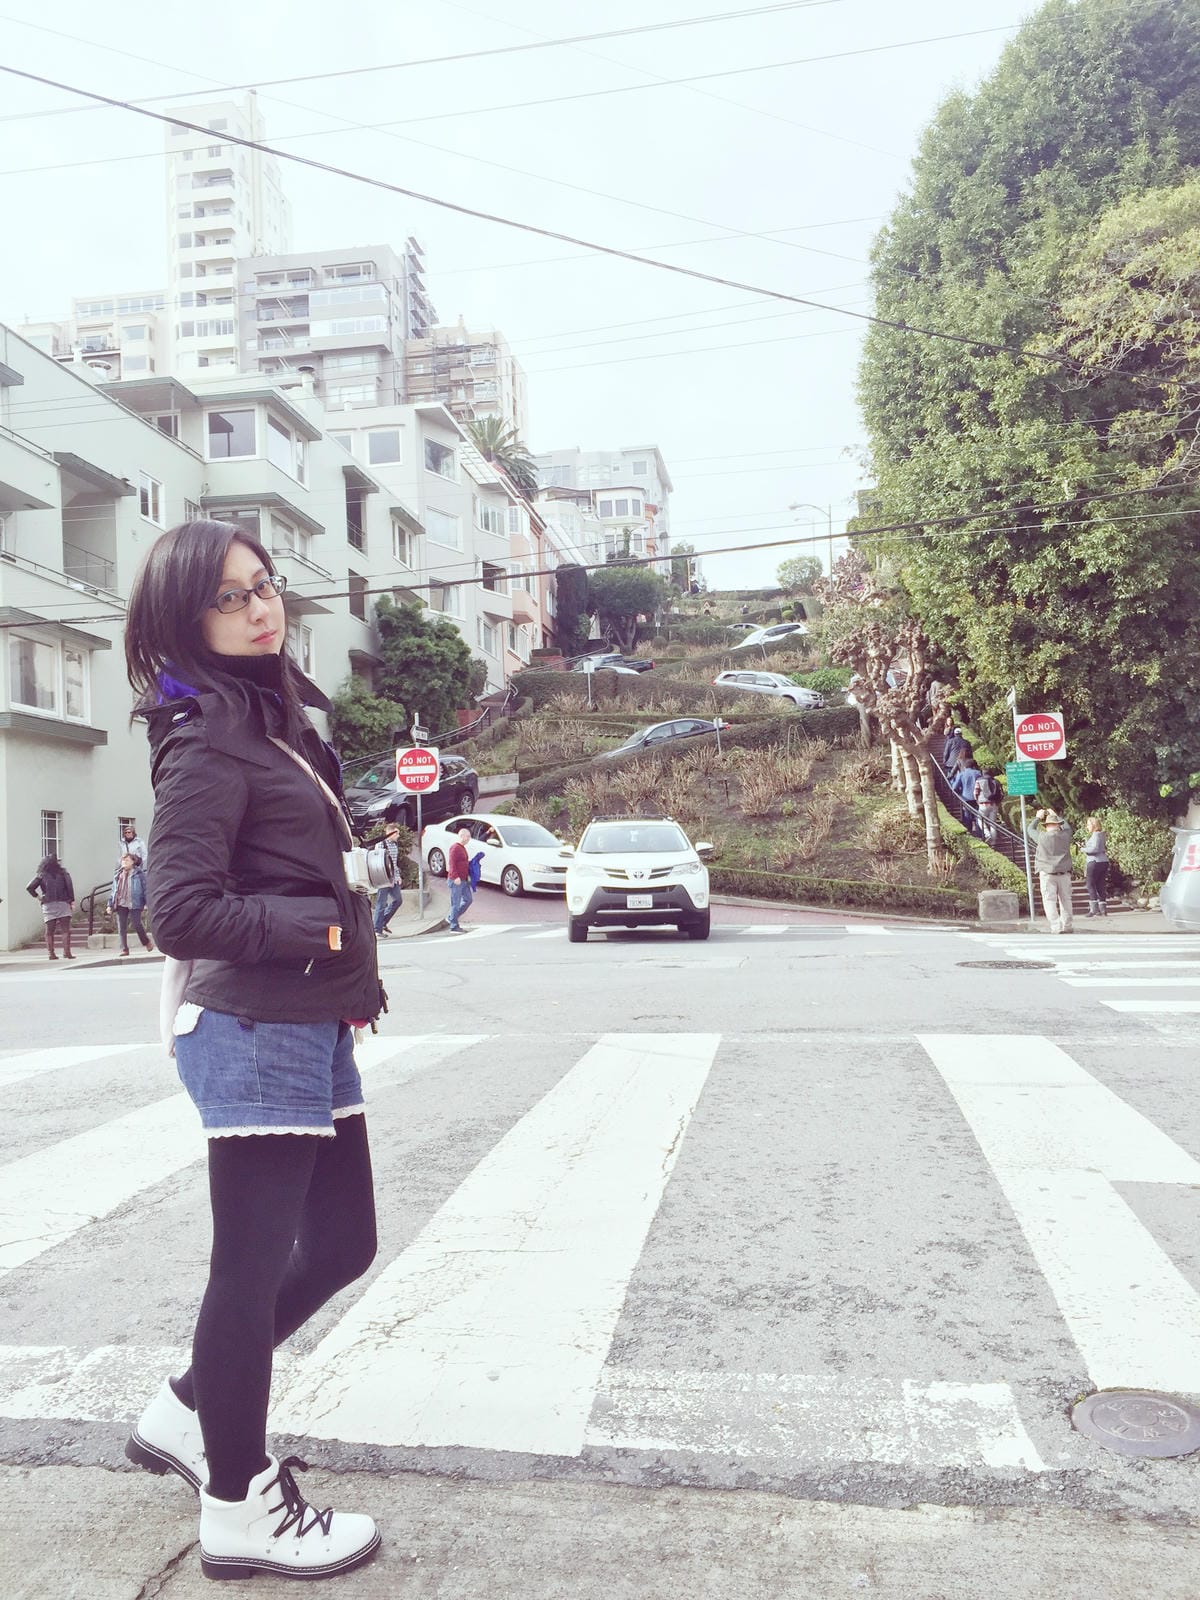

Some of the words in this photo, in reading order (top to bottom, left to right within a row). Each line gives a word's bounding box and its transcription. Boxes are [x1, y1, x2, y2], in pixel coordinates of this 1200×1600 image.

[1022, 724, 1034, 732] DO
[1038, 722, 1056, 731] NOT
[1027, 743, 1055, 752] ENTER
[402, 757, 414, 765] DO
[416, 756, 432, 764] NOT
[406, 775, 430, 784] ENTER
